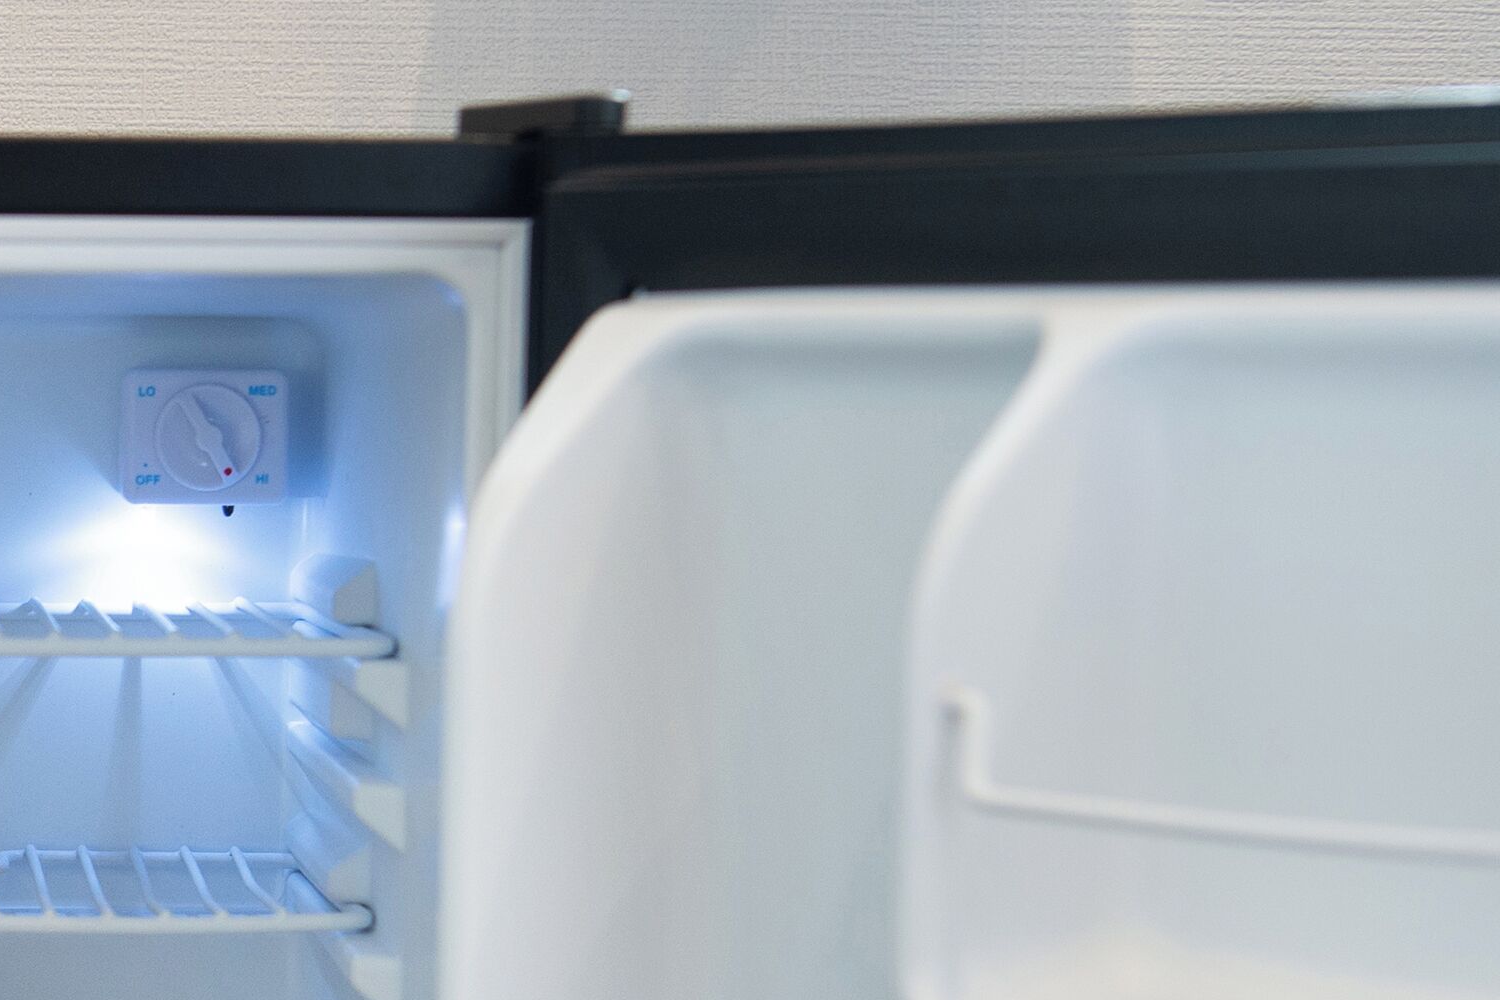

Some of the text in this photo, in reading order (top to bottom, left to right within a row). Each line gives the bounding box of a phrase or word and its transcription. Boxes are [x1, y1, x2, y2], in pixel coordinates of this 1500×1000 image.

[138, 386, 156, 397] LO
[248, 385, 277, 396] MED
[135, 475, 161, 485] OFF
[255, 474, 269, 484] HI
